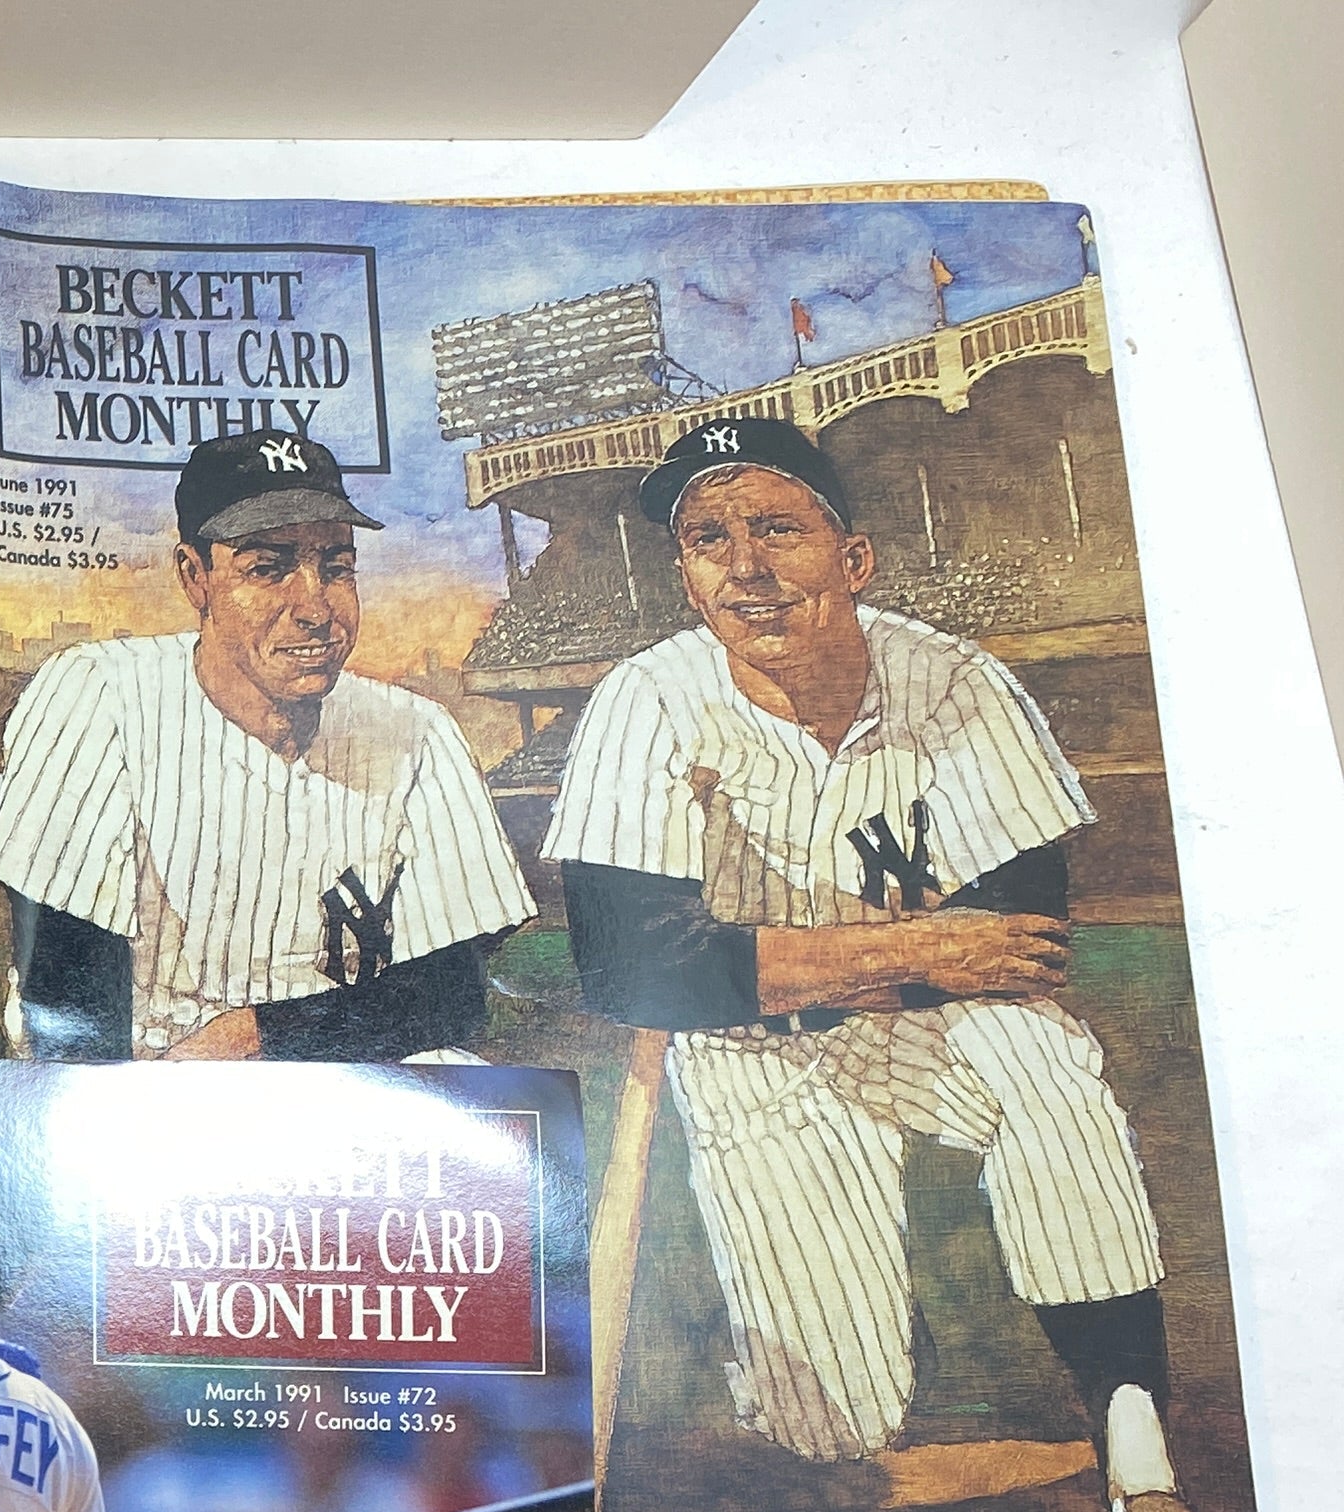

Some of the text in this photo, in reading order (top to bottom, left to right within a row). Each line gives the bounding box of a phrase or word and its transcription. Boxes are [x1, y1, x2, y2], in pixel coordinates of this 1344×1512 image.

[56, 264, 302, 321] BECKETT
[20, 320, 350, 390] BASEBALL CARD
[35, 478, 77, 497] 1991
[39, 502, 74, 520] #75
[33, 522, 84, 543] $2.95
[90, 526, 100, 547] /
[67, 550, 119, 570] $3.95
[134, 1204, 505, 1276] BASEBALL CARD
[170, 1280, 469, 1343] MONTHLY
[205, 1382, 437, 1406] March 1991 Issue #72
[186, 1408, 457, 1433] U.S. $2.95 / Canada $3.95
